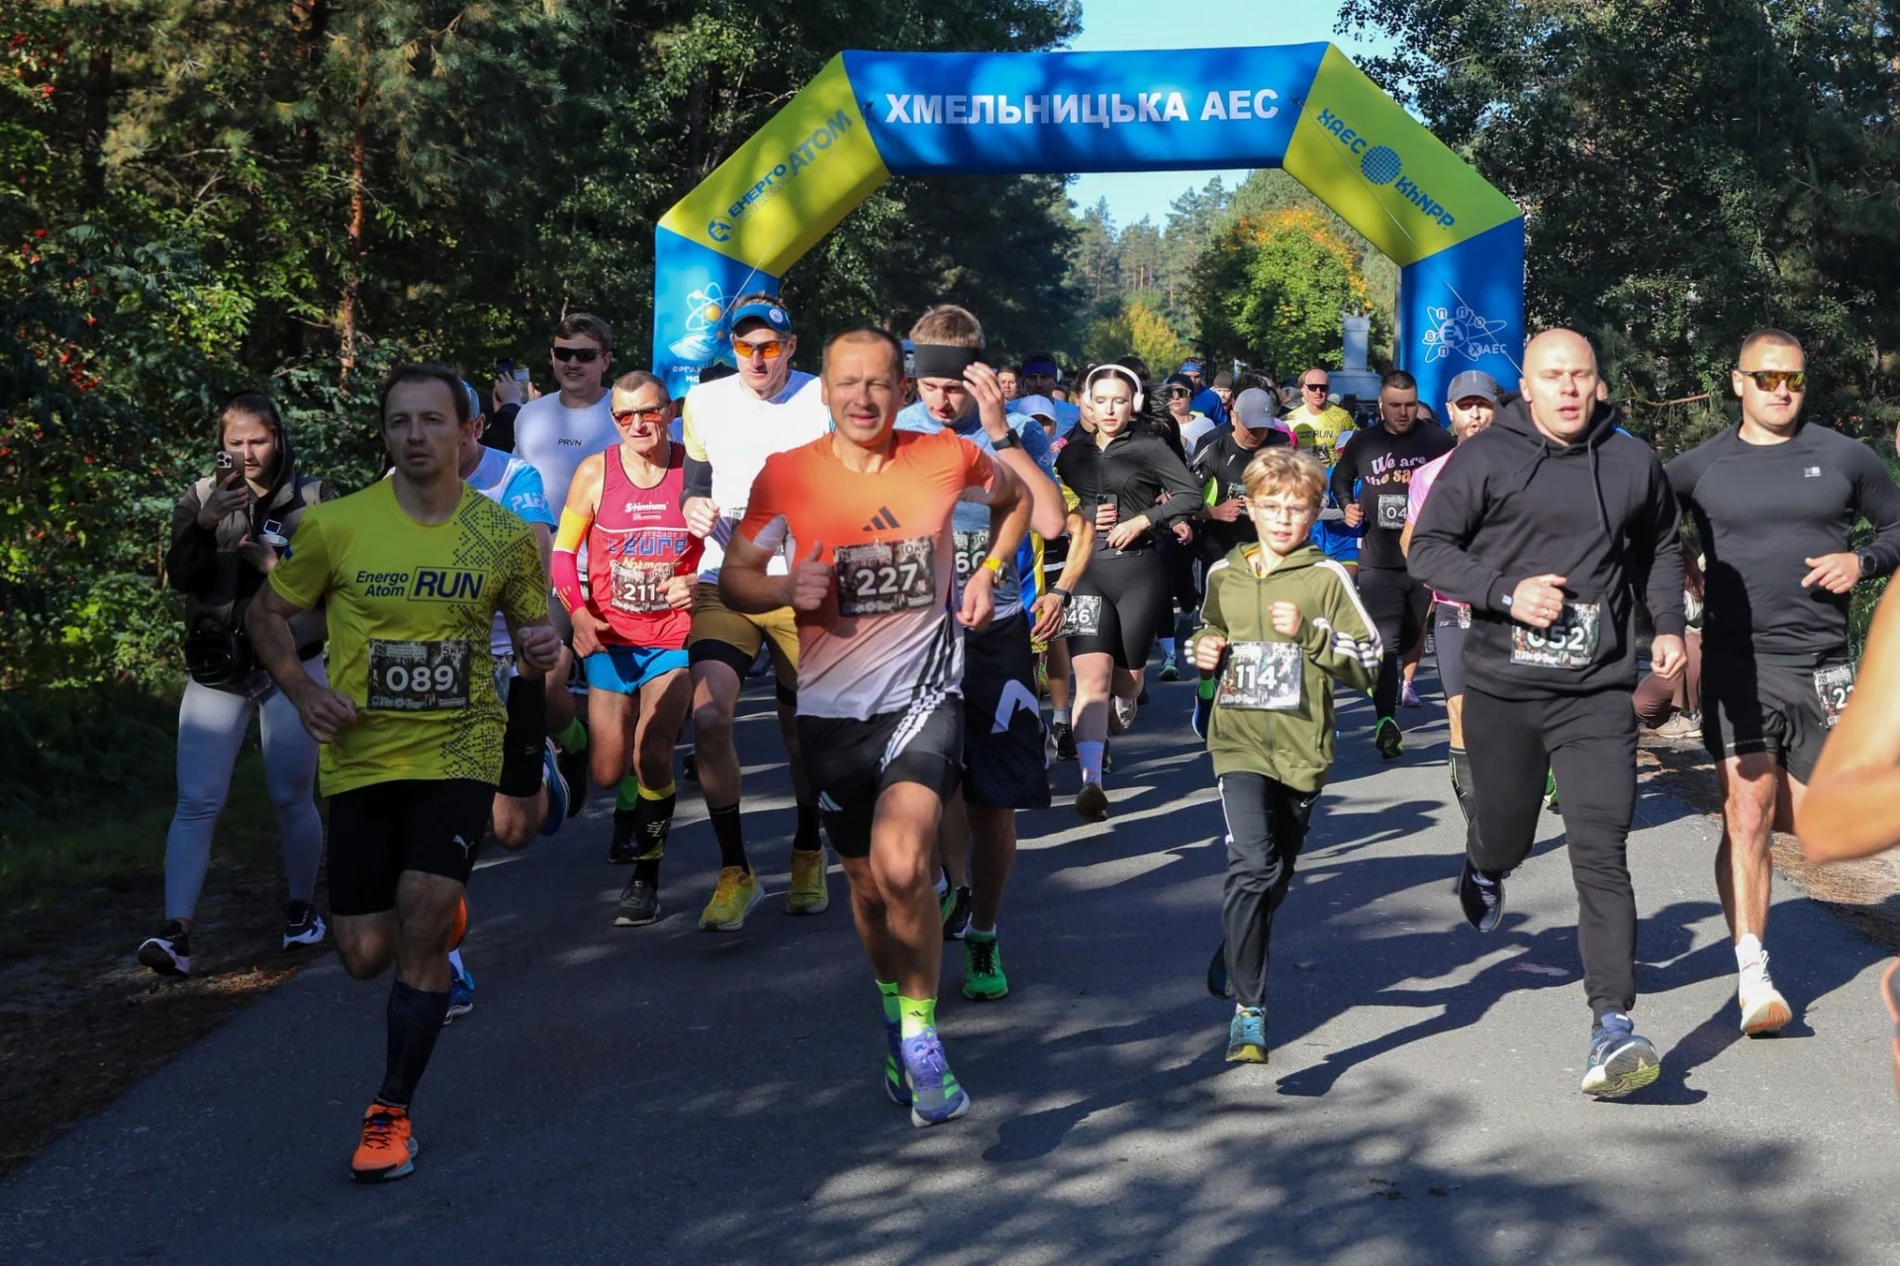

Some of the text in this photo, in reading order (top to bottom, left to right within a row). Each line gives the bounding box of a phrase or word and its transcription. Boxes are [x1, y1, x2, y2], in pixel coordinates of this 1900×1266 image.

[885, 89, 1279, 128] ХМЕЛЬНИЦЬКА АЕС
[727, 163, 787, 218] ЕНЕРГО
[788, 109, 854, 177] АТОМ
[557, 438, 582, 446] PRVN
[1371, 452, 1426, 475] We are
[1365, 473, 1390, 486] the
[356, 571, 409, 586] Energo
[364, 584, 405, 597] Atom
[413, 570, 483, 599] RUN
[856, 563, 918, 597] 227
[623, 583, 656, 602] 211
[1527, 626, 1585, 650] 052
[443, 646, 467, 656] 5KM
[386, 665, 454, 692] 089
[1236, 664, 1277, 690] 114
[1832, 685, 1856, 710] 2
